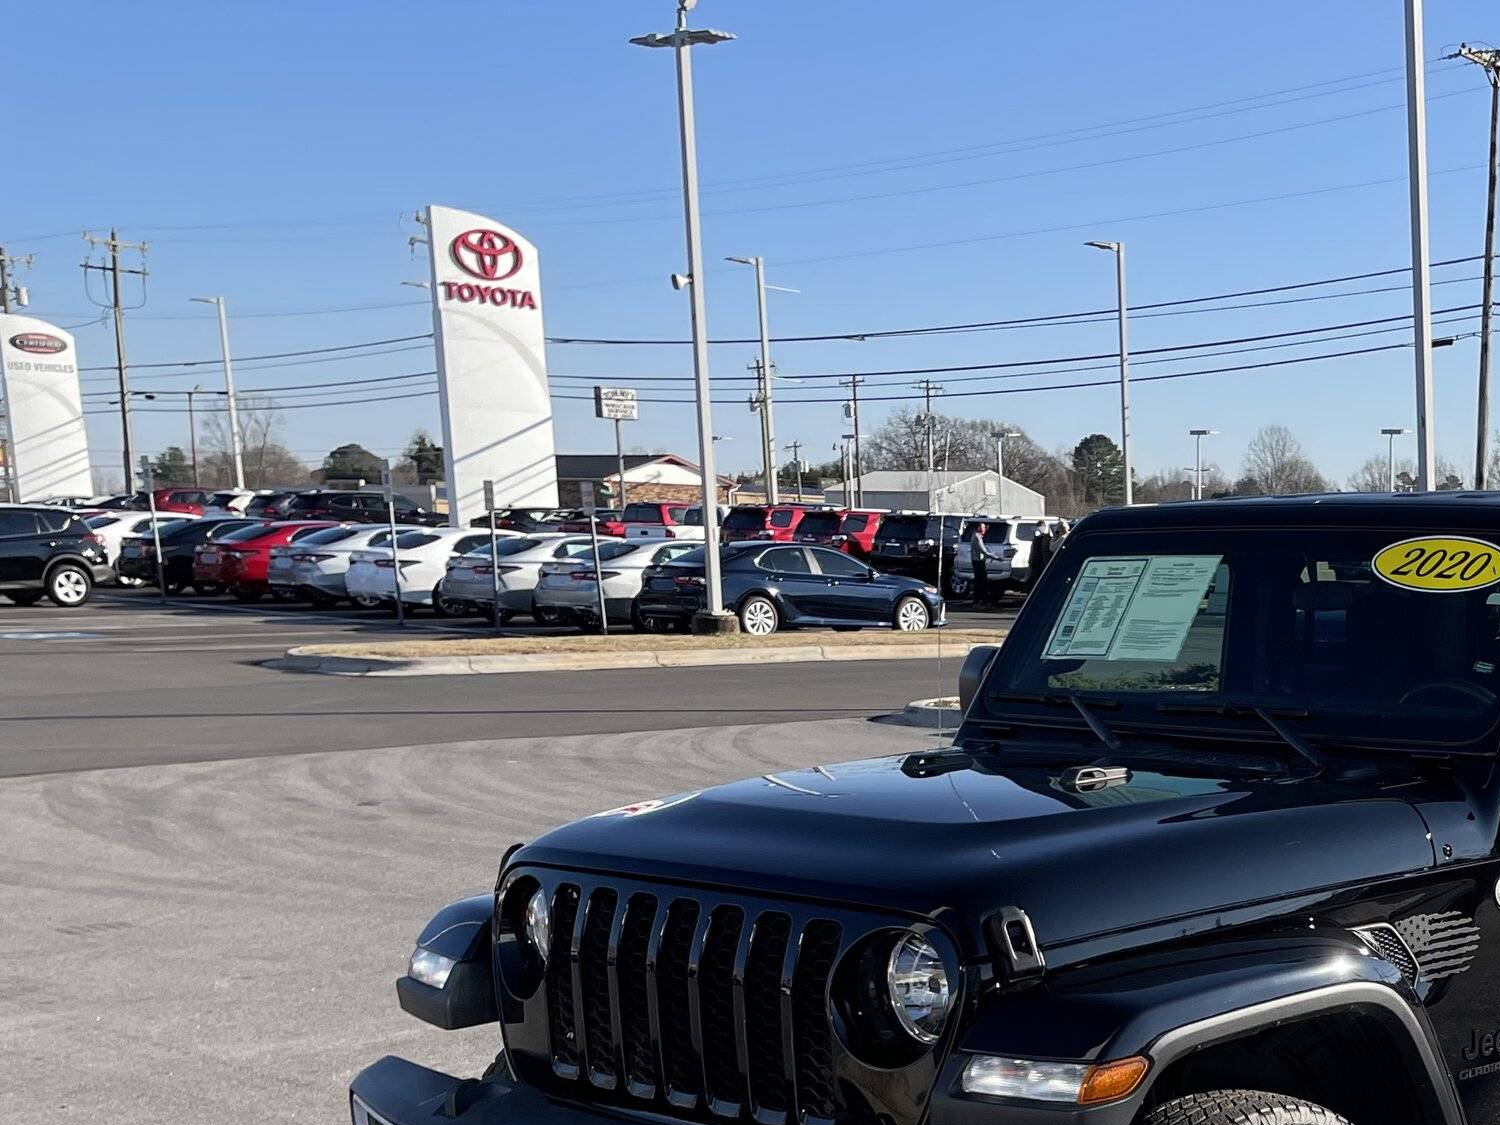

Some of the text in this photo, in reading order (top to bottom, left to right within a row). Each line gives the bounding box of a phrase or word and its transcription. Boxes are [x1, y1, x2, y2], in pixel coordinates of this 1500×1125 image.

[439, 281, 537, 310] TOYOTA
[7, 361, 74, 373] USED VEHICLES
[1390, 548, 1493, 581] 2020
